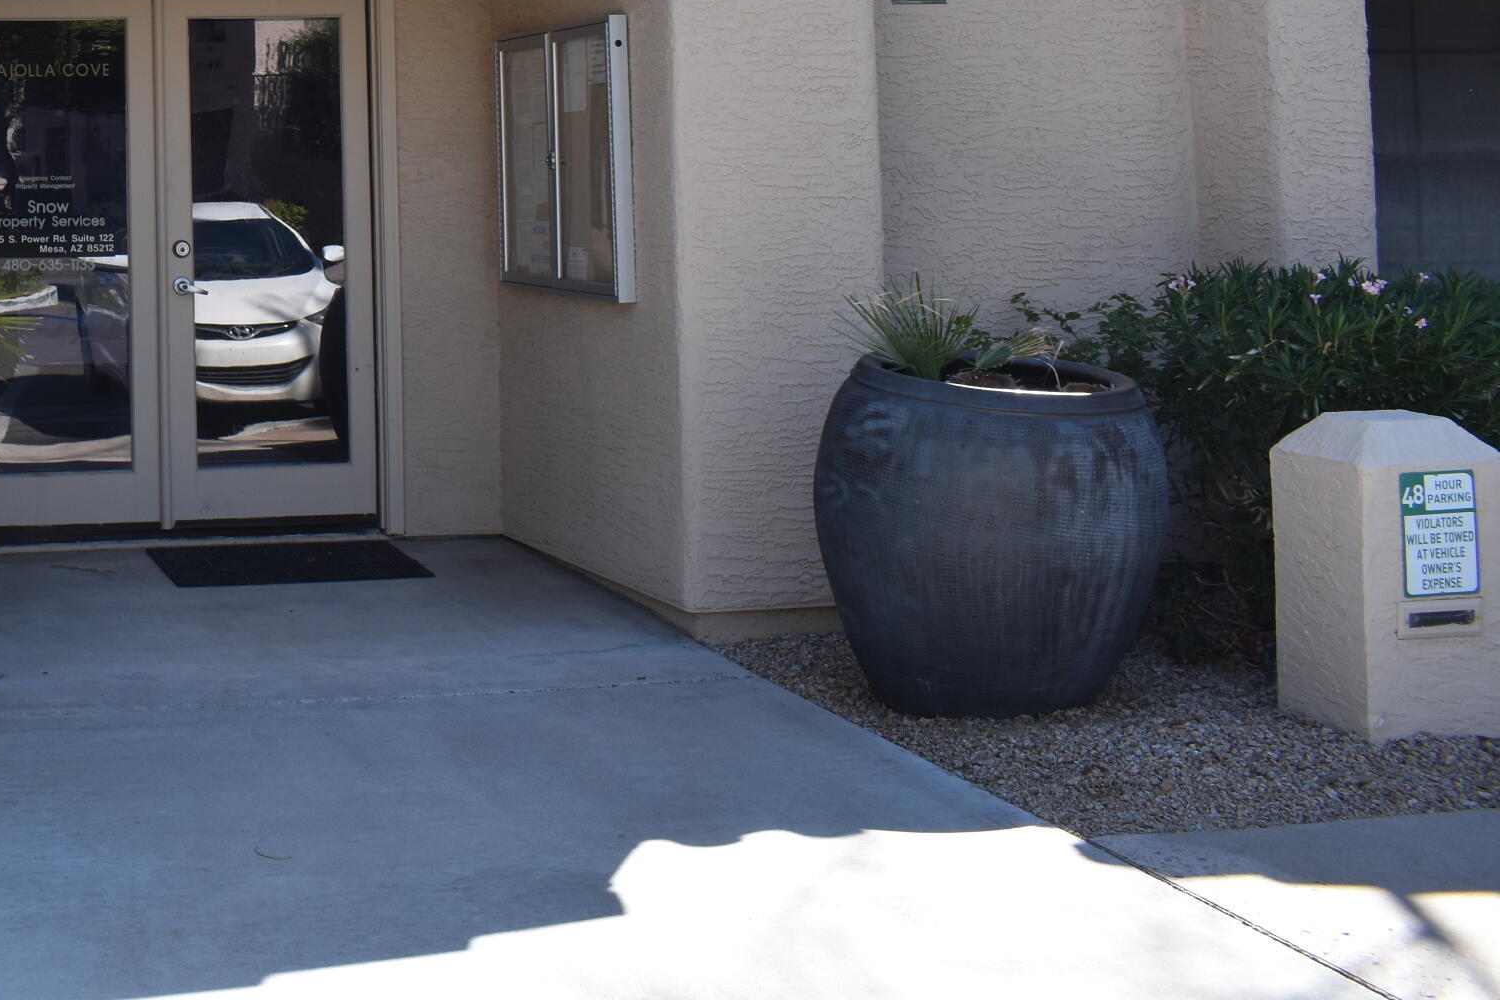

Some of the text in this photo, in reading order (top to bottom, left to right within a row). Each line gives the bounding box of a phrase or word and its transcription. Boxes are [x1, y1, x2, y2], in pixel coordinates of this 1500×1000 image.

[62, 63, 109, 77] COVE
[27, 199, 69, 214] Snow
[51, 216, 106, 227] Services
[8, 235, 18, 243] S.
[21, 234, 49, 243] Power
[53, 234, 68, 242] Rd.
[71, 233, 95, 242] Suite
[99, 233, 114, 242] 122
[39, 244, 115, 254] Mesa, AZ 85212
[2, 258, 96, 271] 480-635-1133
[1435, 479, 1462, 490] HOUR
[1402, 484, 1424, 508] 48
[1427, 492, 1472, 504] PARKING
[1416, 516, 1463, 529] VIOLATORS
[1406, 531, 1474, 545] WILL BE TOWED
[1417, 546, 1465, 560] AT VEHICLE
[1422, 562, 1461, 574] OWNER'S
[1422, 577, 1462, 590] EXPENSE
